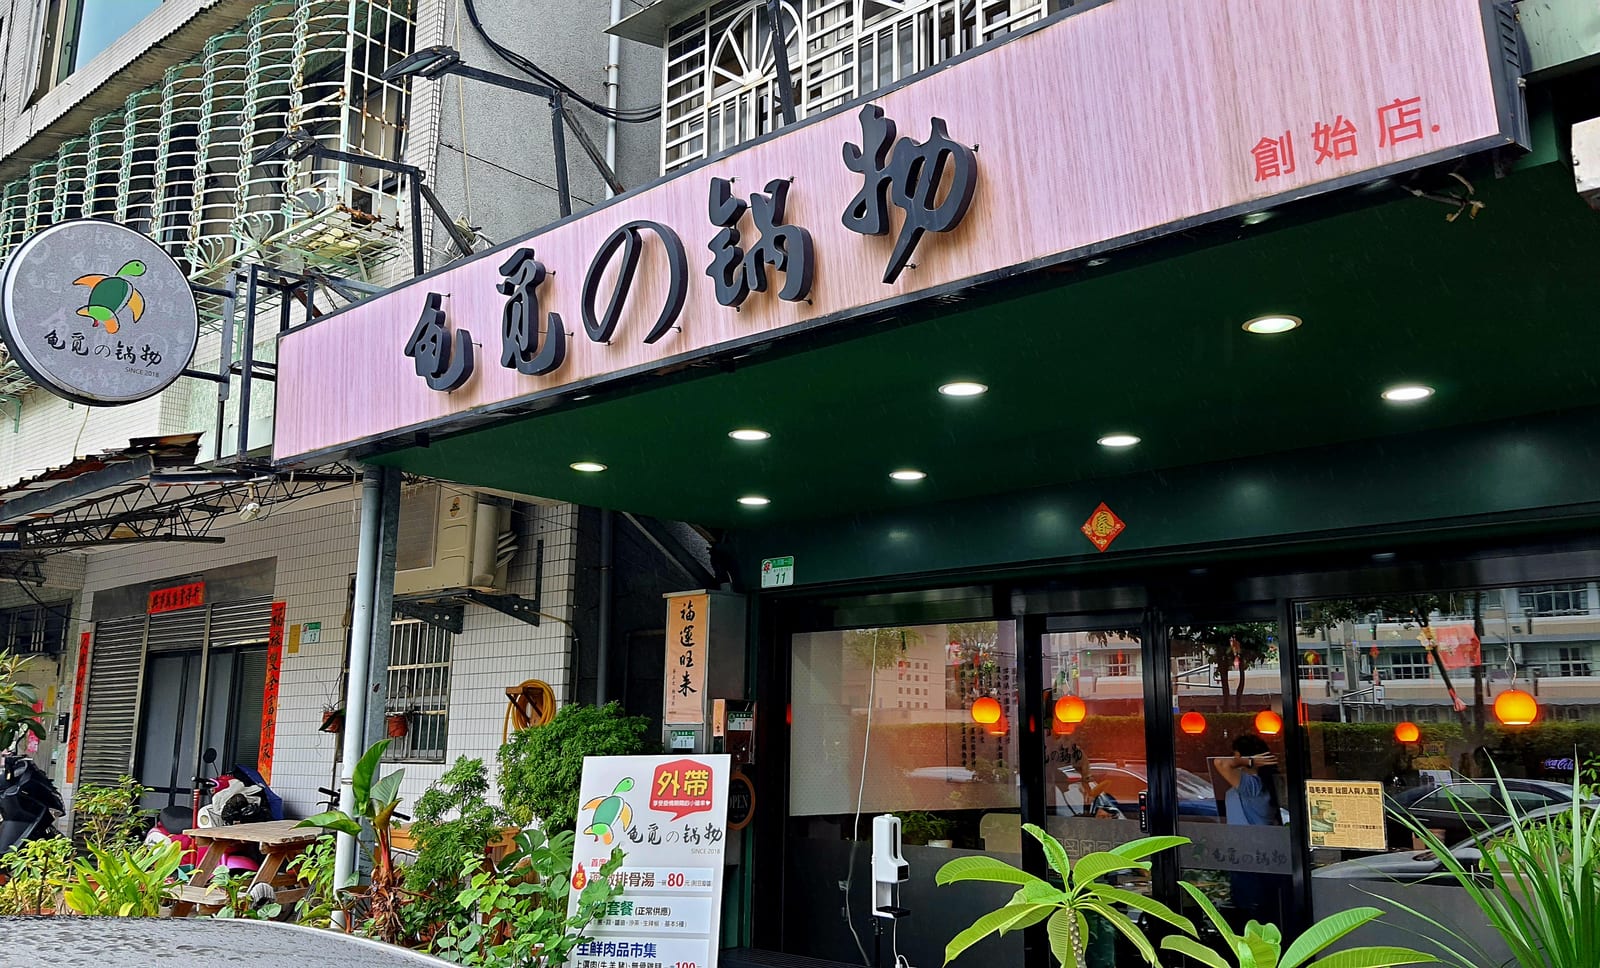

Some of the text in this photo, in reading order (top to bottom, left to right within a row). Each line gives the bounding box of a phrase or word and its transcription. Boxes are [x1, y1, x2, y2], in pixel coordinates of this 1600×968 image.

[124, 366, 160, 378] SINCE 2018
[775, 572, 786, 585] 11
[657, 769, 709, 797] 外帶
[667, 872, 685, 887] 80
[576, 941, 657, 958] 生鮮肉品市集
